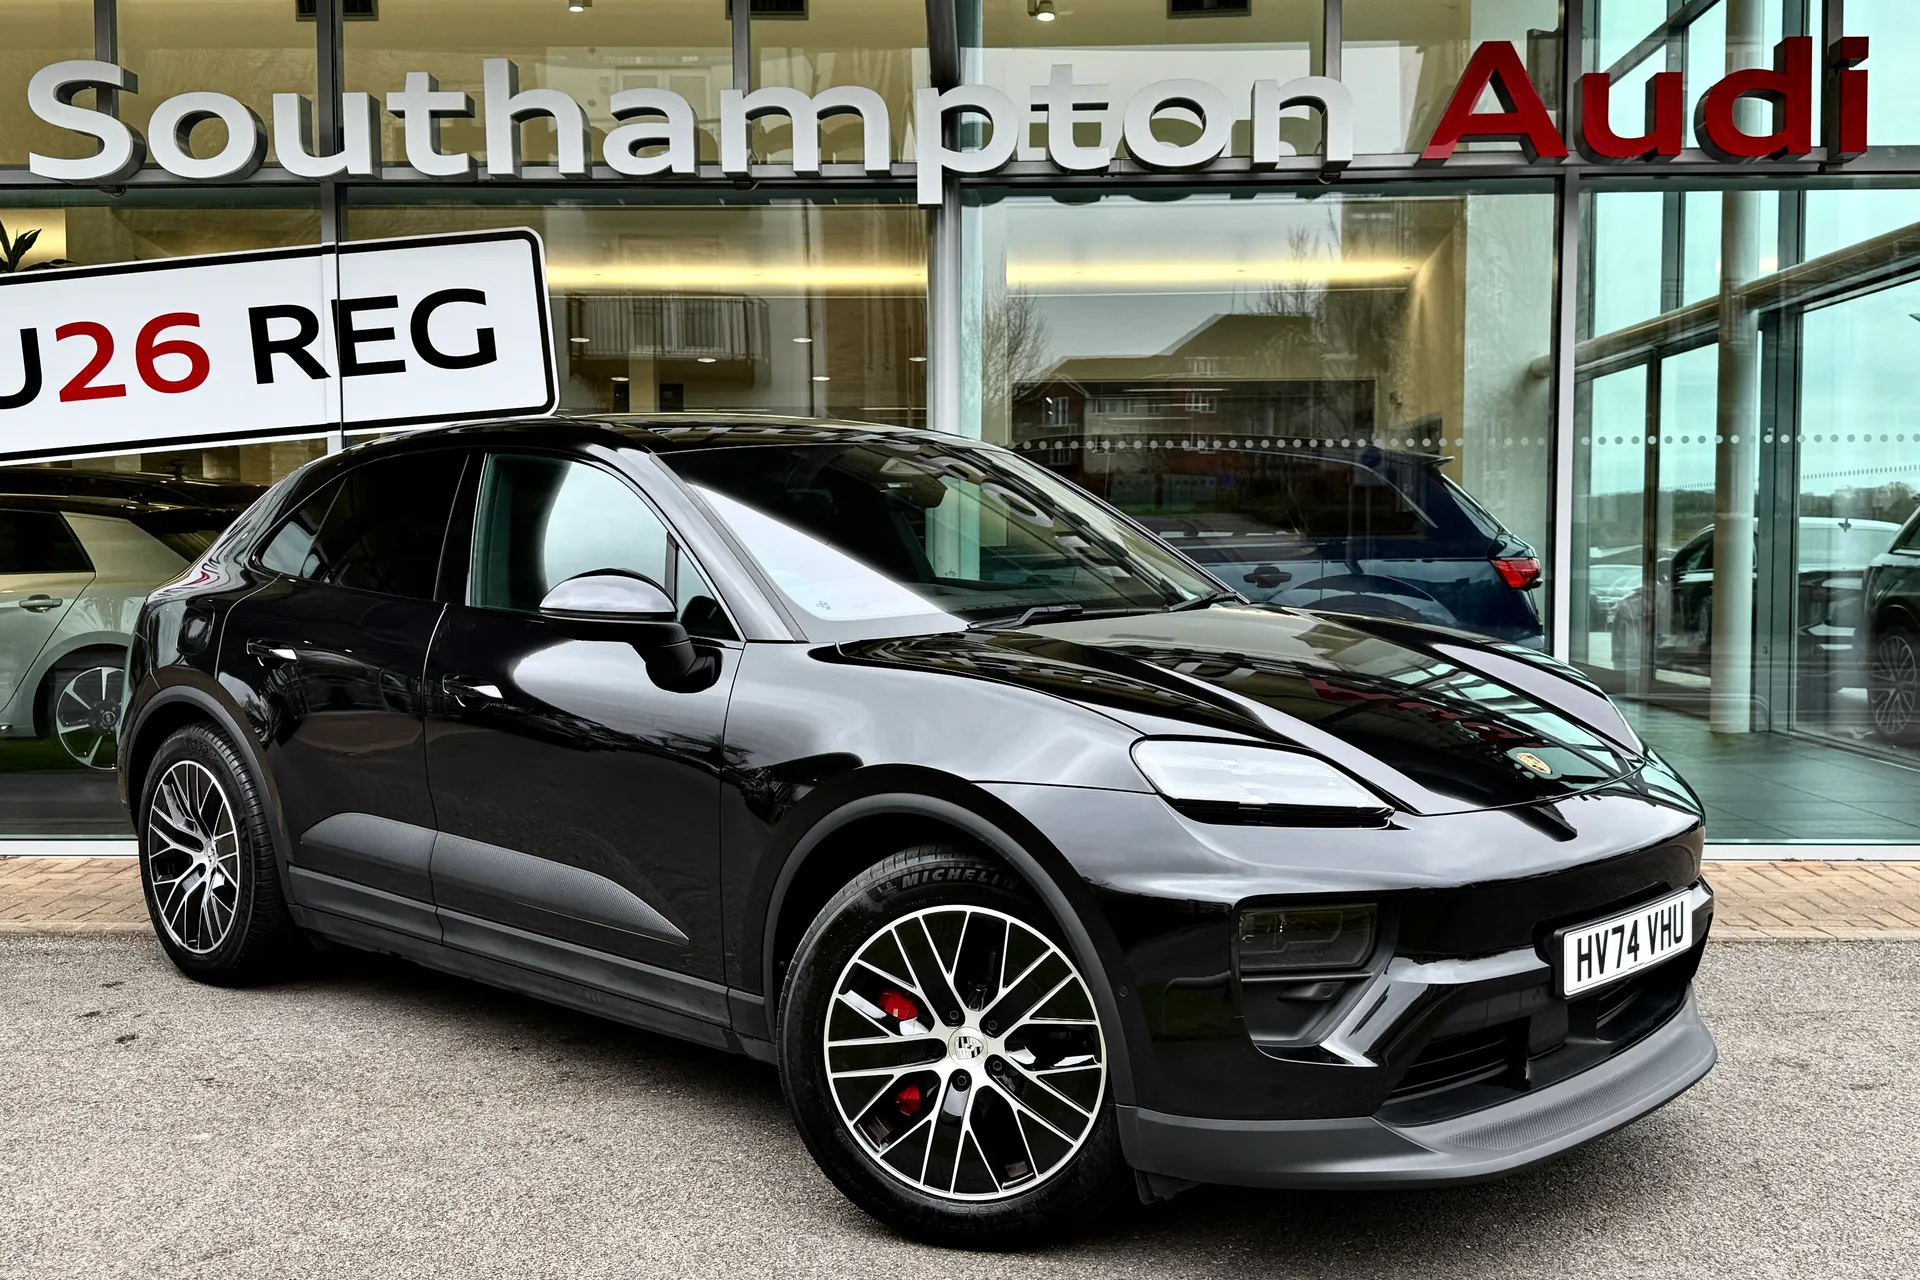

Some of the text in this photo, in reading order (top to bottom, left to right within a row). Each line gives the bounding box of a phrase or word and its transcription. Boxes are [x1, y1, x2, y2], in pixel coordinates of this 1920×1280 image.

[26, 36, 1870, 208] Southampton Audi
[248, 288, 497, 385] REG
[902, 867, 1021, 890] MICHELIN
[1576, 901, 1684, 982] HV74 VHU
